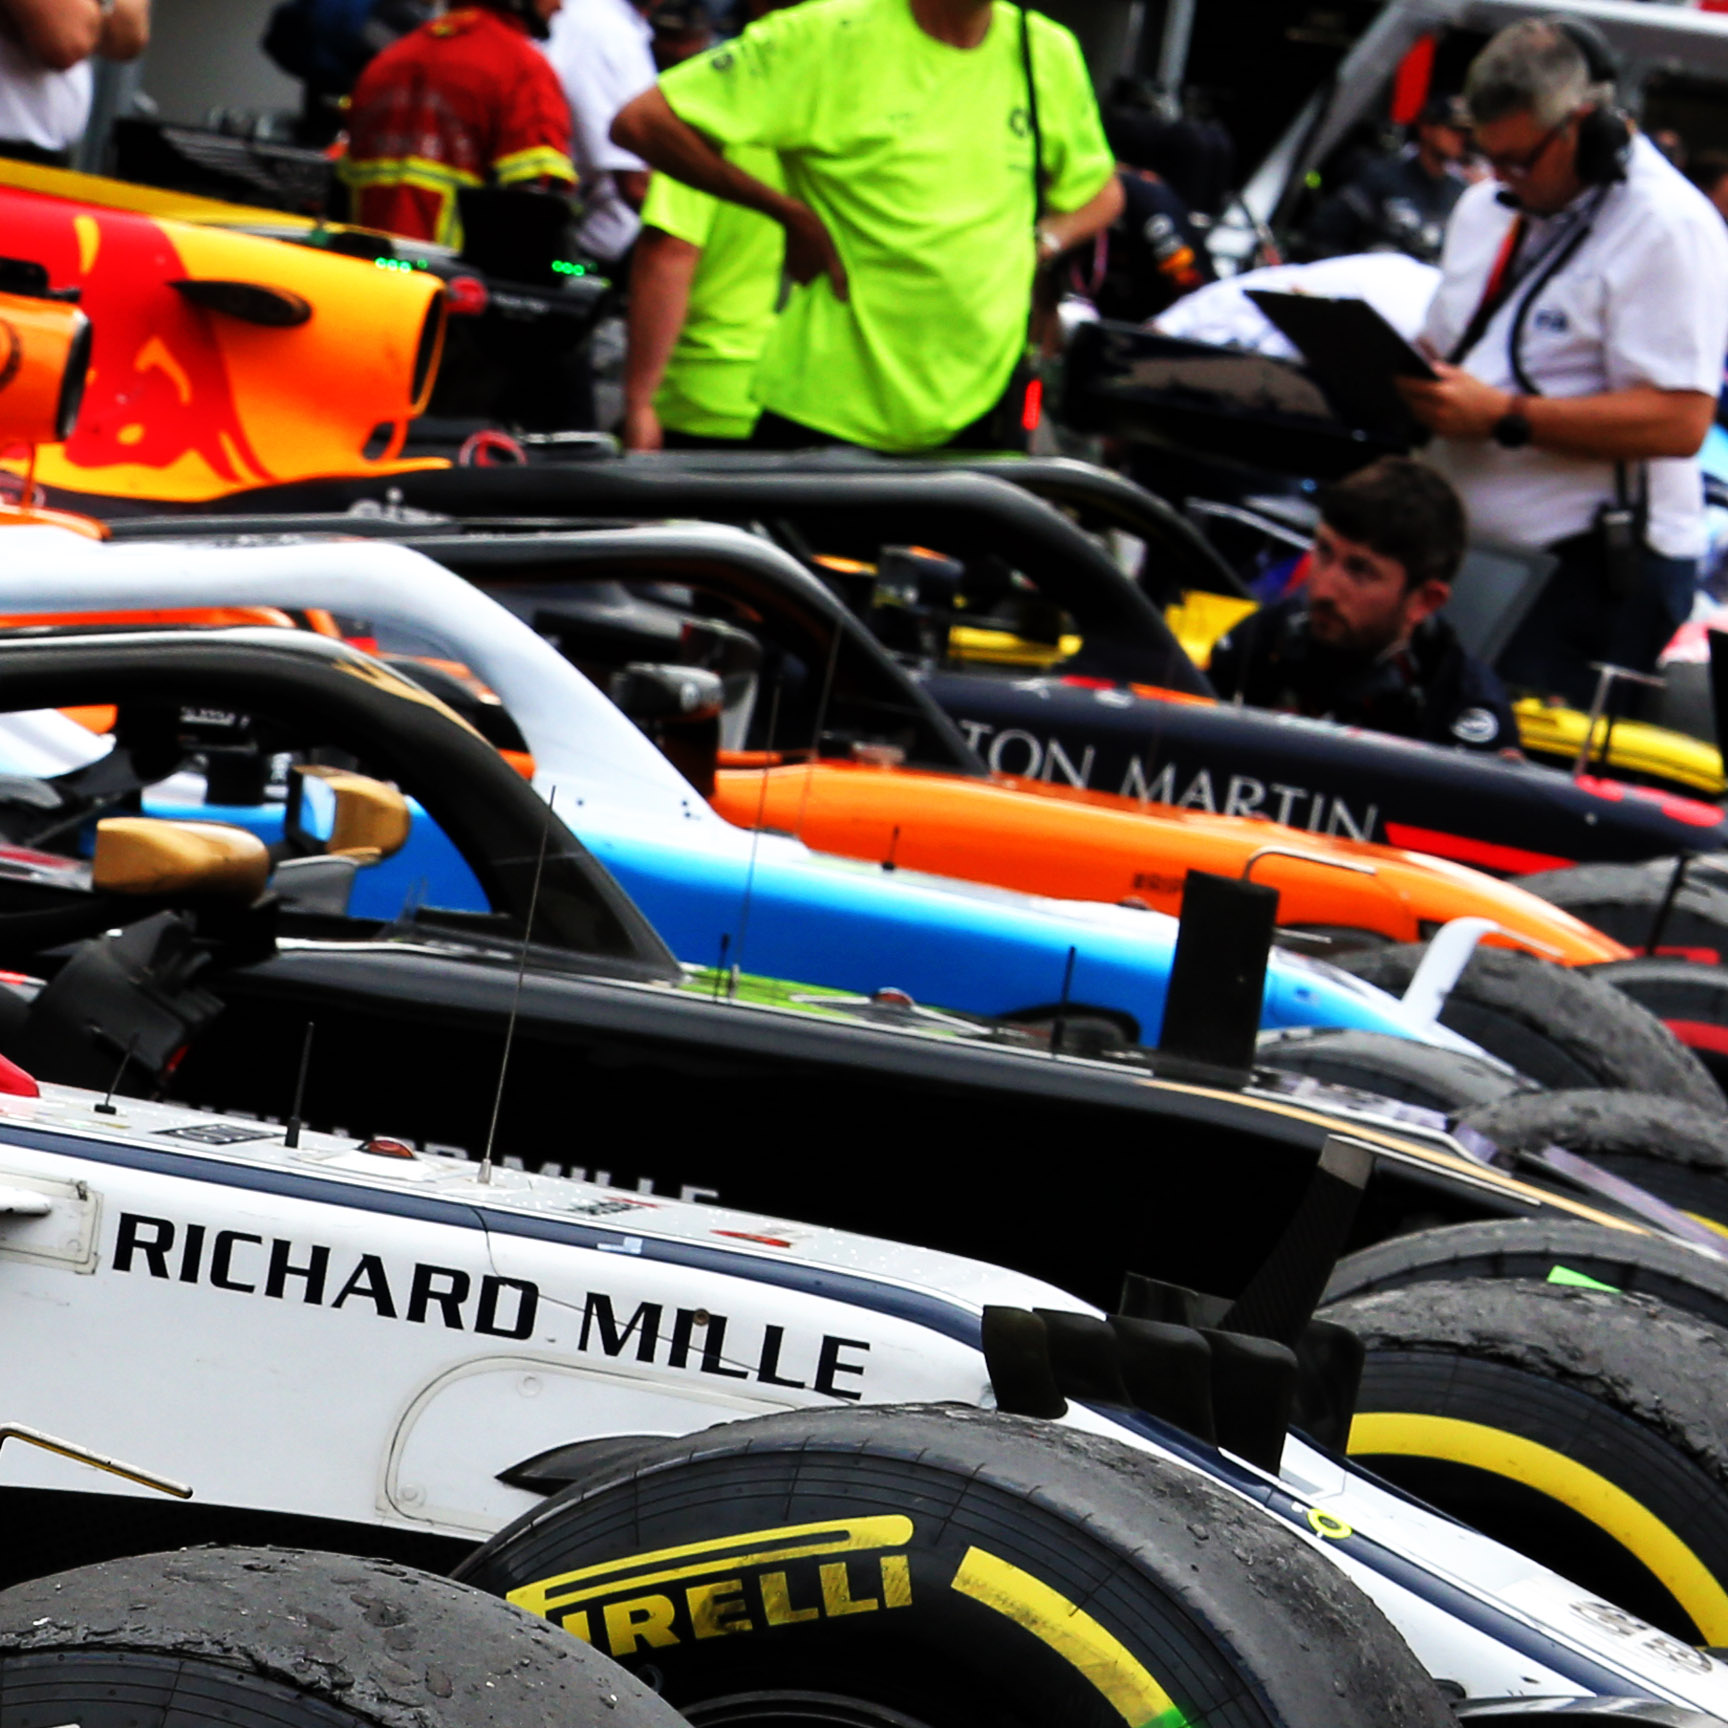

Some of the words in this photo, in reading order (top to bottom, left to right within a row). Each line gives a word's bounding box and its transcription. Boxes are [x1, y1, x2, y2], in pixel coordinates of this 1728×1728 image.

[1119, 754, 1379, 842] MARTIN
[112, 1212, 540, 1341] RICHARD
[577, 1290, 871, 1401] MILLE
